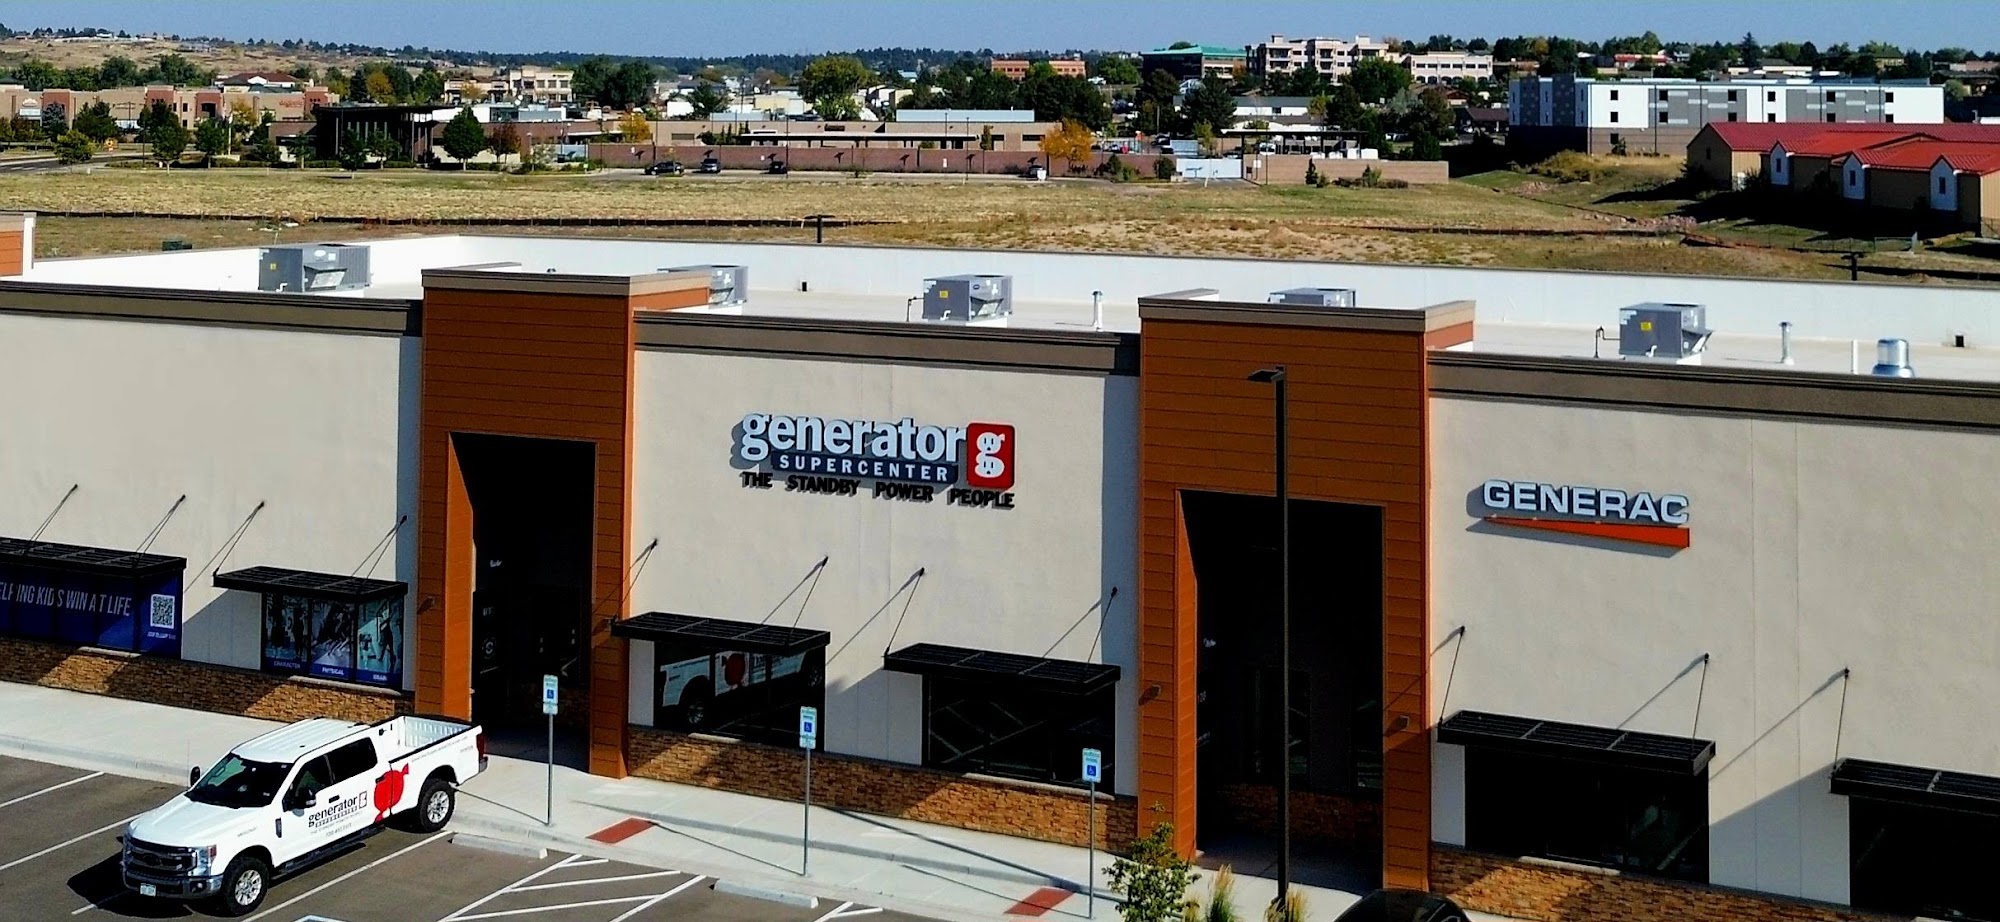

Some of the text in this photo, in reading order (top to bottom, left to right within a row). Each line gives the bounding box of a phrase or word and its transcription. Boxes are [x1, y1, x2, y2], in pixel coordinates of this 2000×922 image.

[741, 413, 966, 462] generator
[779, 454, 948, 482] SUPERCENTER
[740, 471, 1015, 508] THE STANDBY POWER PEOPLE
[1484, 479, 1689, 524] GENERAC
[66, 589, 88, 612] WIN
[107, 594, 132, 617] LIFE
[308, 796, 357, 828] generator
